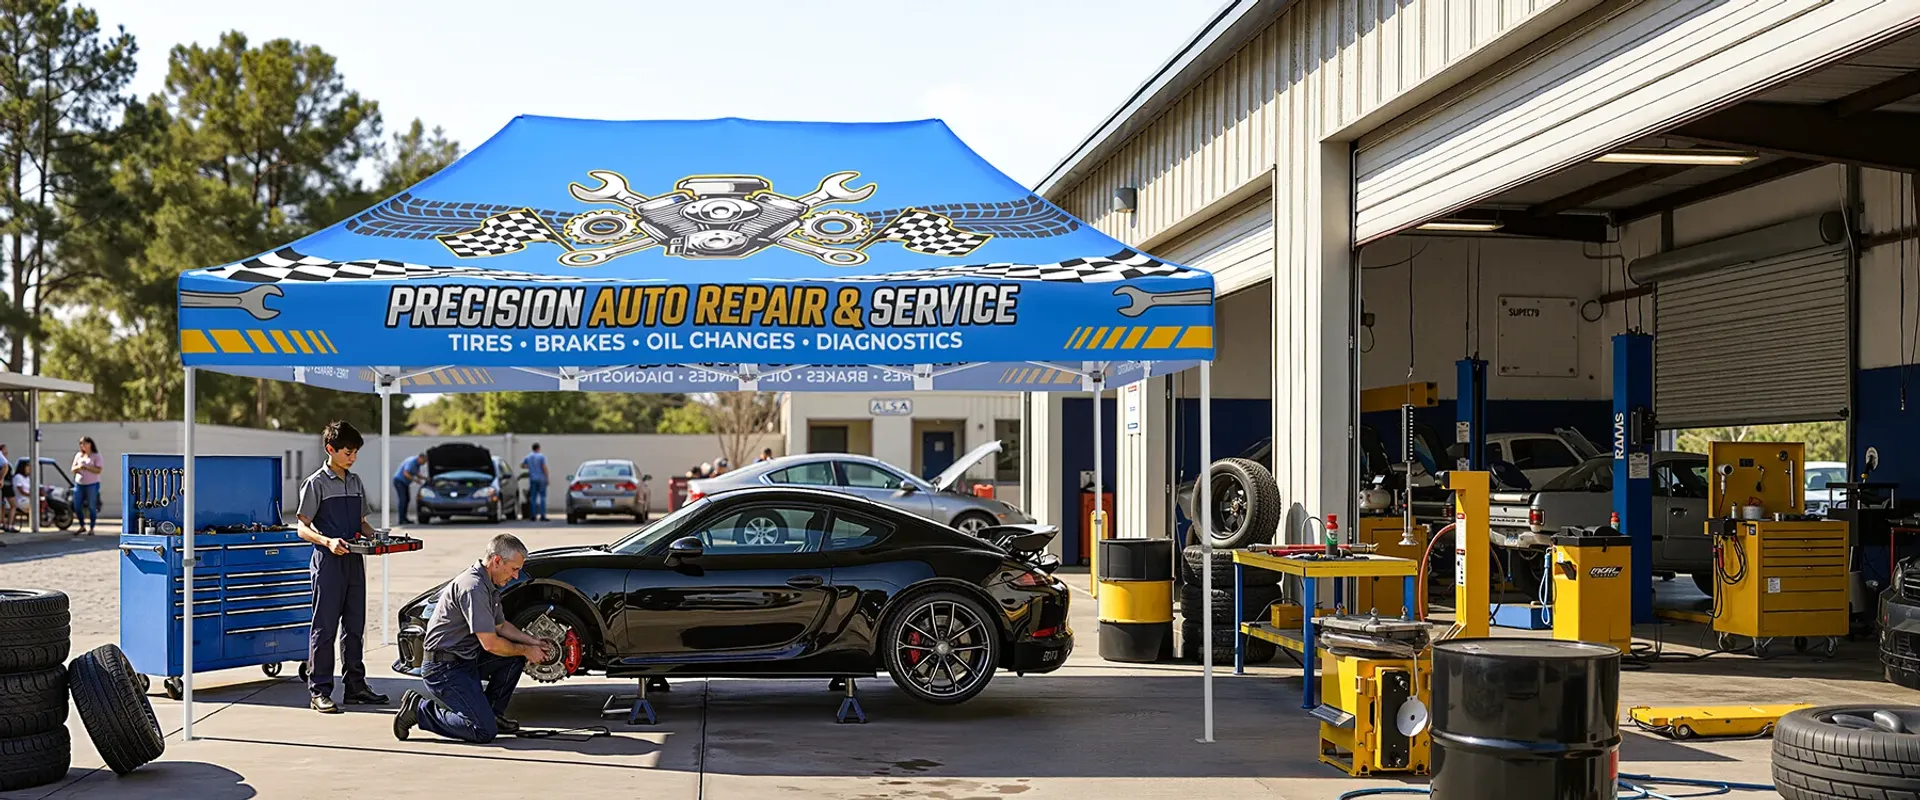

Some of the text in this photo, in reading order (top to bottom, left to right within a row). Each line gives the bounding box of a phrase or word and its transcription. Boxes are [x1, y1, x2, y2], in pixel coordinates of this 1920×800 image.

[385, 283, 1020, 329] PRECISION AUTO REPAIR & SERVICE
[448, 331, 963, 351] TIRES BRAKES OIL CHANGES DIAGNOSTICS
